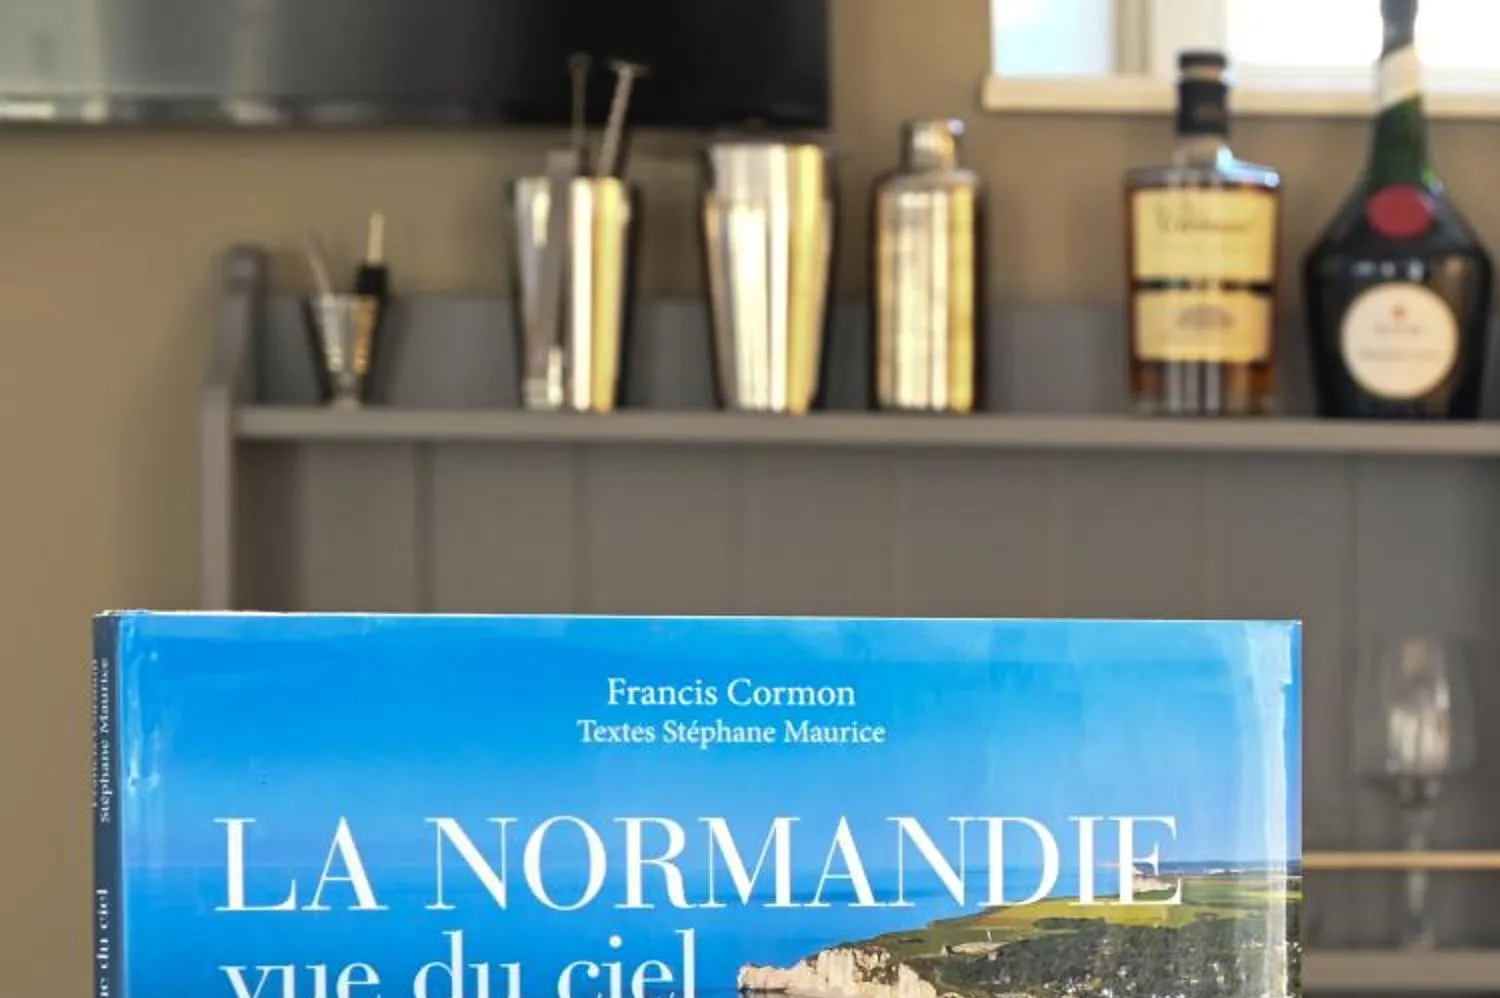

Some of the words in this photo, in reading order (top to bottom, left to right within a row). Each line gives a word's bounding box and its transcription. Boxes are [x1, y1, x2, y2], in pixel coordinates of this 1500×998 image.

[607, 676, 718, 706] Francis
[727, 677, 856, 706] Cormon
[576, 718, 656, 743] Textes
[663, 718, 776, 749] Stéphane
[784, 718, 887, 743] Maurice
[213, 815, 390, 912] LA
[424, 814, 1183, 911] NORMANDIE
[95, 888, 110, 930] ciel
[95, 936, 110, 971] du
